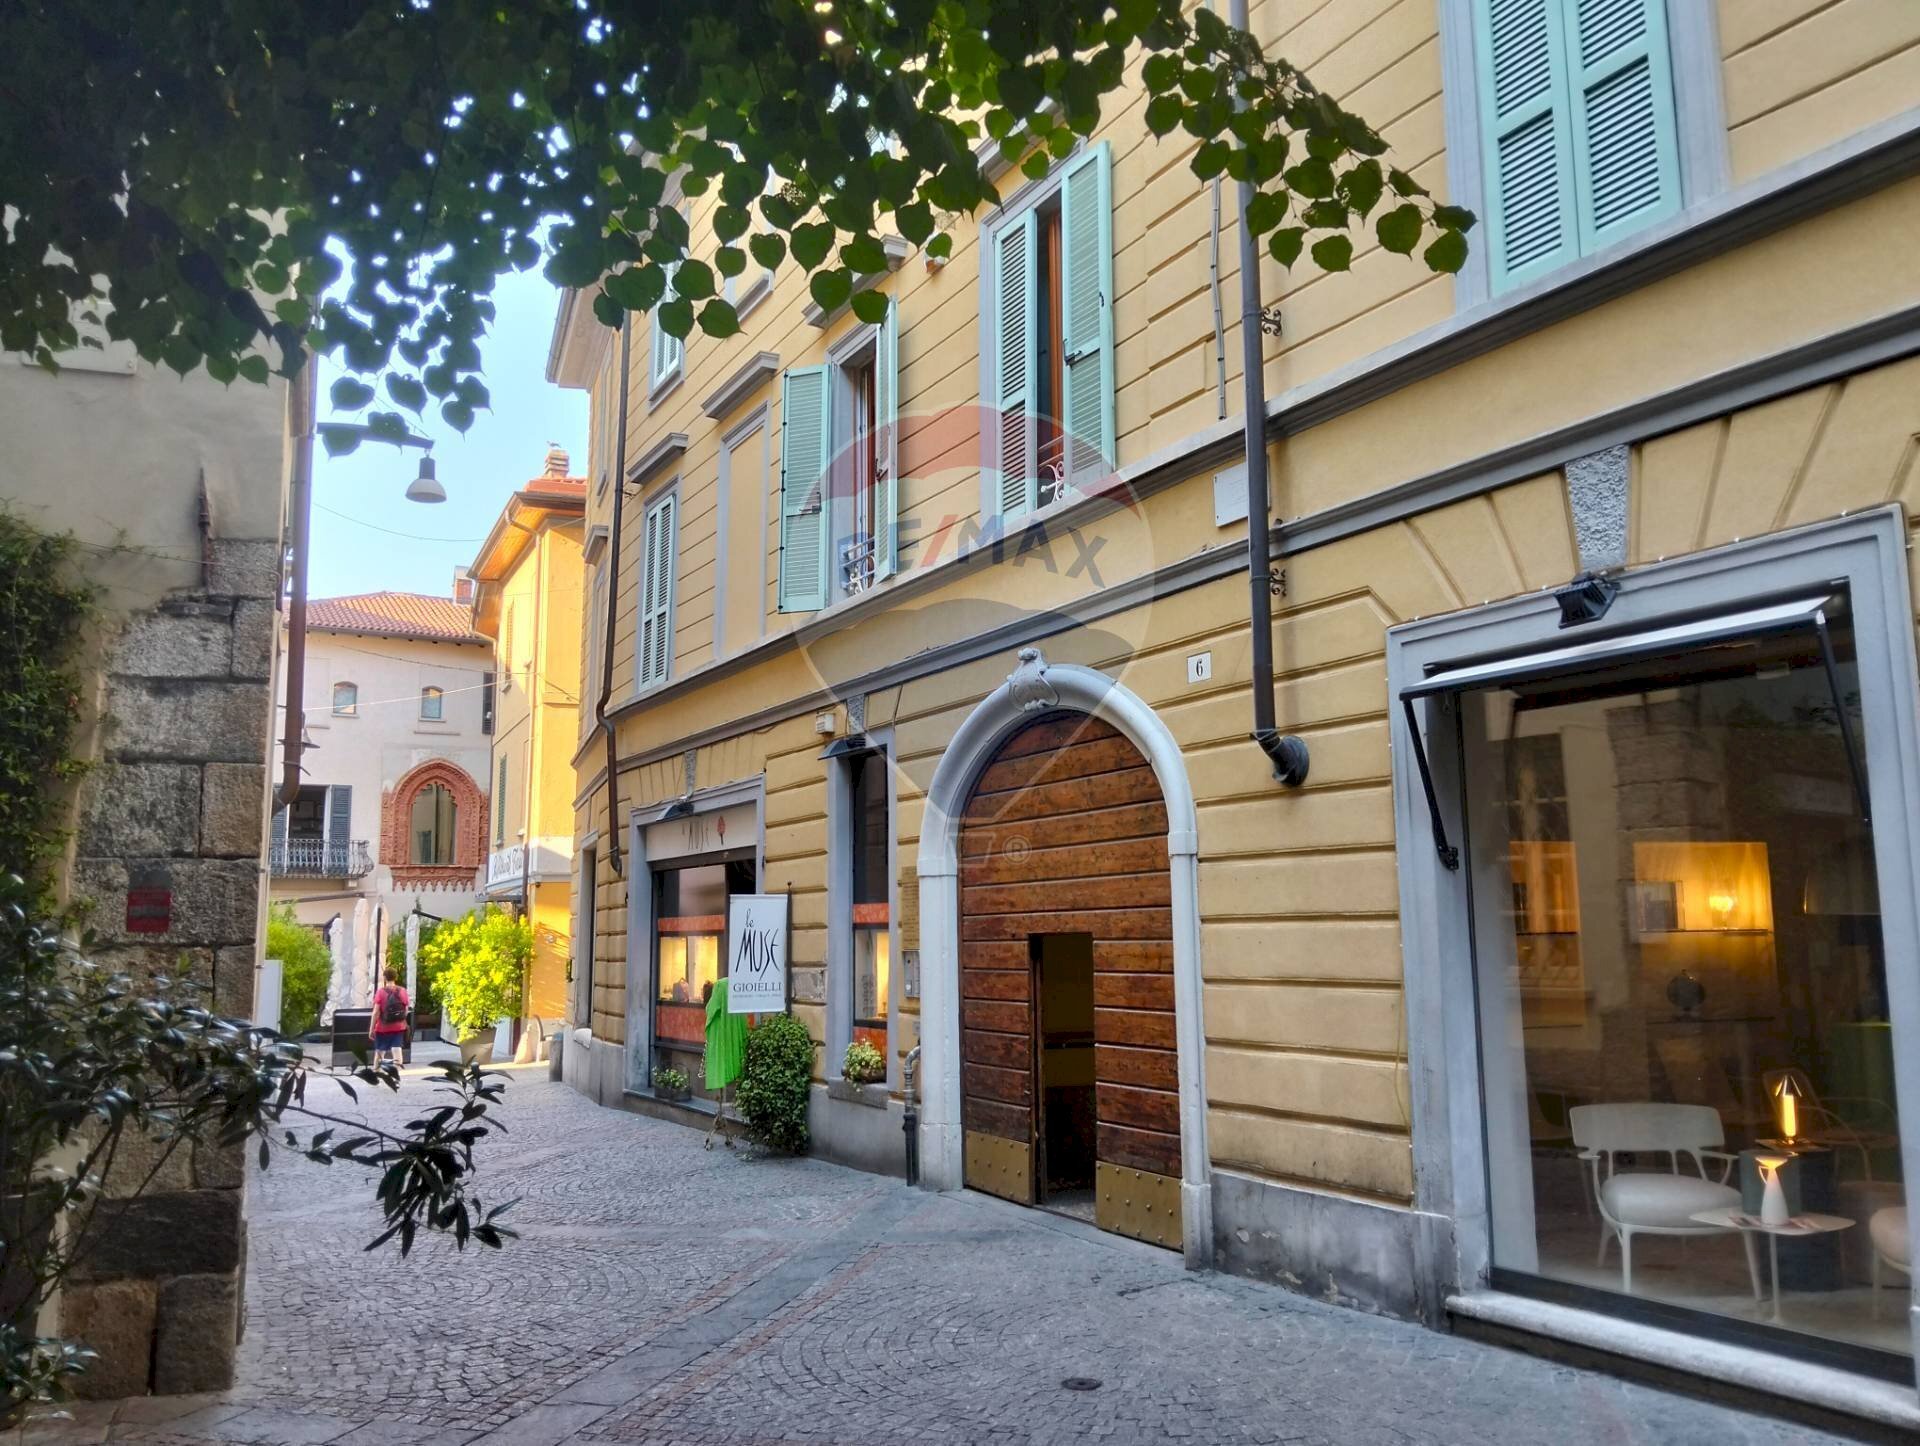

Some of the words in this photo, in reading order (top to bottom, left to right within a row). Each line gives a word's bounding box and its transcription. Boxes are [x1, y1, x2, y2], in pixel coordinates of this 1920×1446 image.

[1196, 658, 1203, 677] 6
[735, 928, 780, 981] MUSE
[733, 982, 782, 992] GIOIELLI
